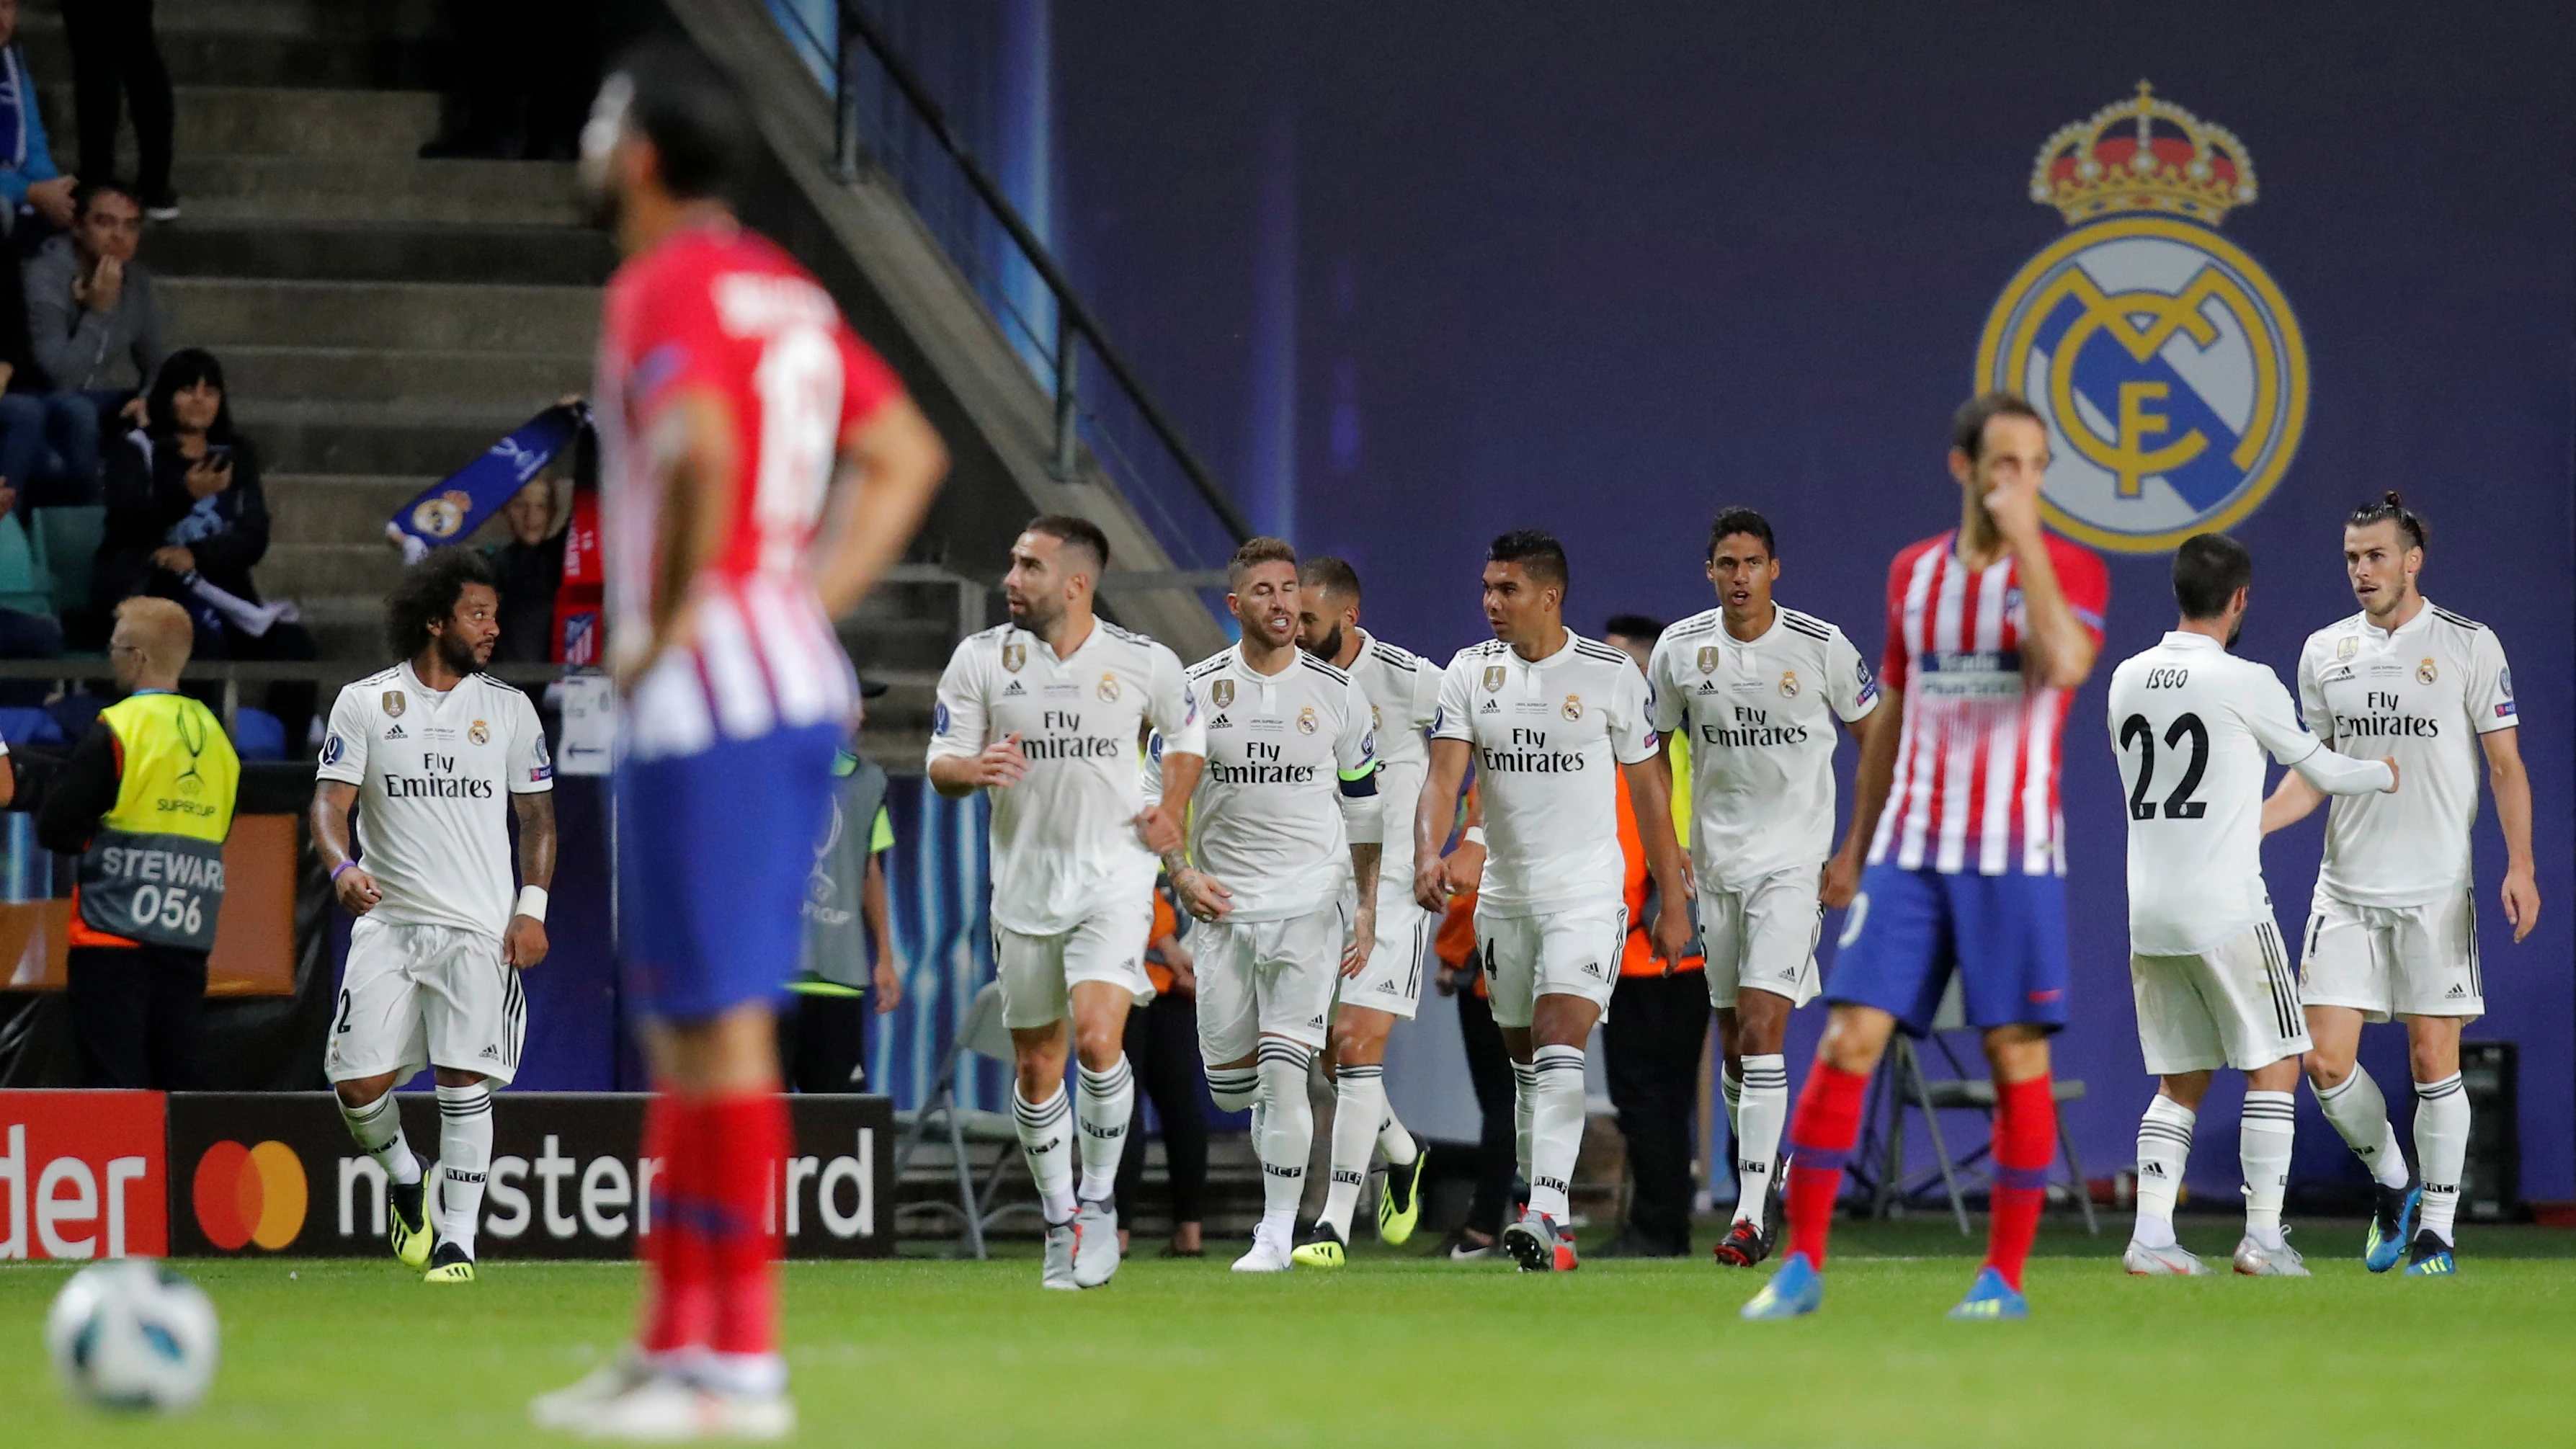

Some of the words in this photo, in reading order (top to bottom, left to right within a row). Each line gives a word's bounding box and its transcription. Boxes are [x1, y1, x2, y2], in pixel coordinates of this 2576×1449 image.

[2146, 668, 2188, 689] ISCO
[2368, 692, 2399, 710] Fly
[1044, 710, 1080, 731] Fly
[1735, 706, 1766, 725] Fly
[2335, 711, 2438, 738] Emirates
[1005, 732, 1118, 759] mirates
[1512, 728, 1546, 749] Fly
[1701, 724, 1807, 747] Emirates
[1247, 741, 1280, 762] Fly
[1483, 747, 1585, 772] Emirates
[424, 754, 455, 773] Fly
[1211, 762, 1315, 783] Emirates
[2120, 713, 2209, 821] 22
[385, 772, 492, 798] Emirates
[102, 847, 225, 892] STEWAR
[131, 885, 202, 935] 056
[339, 1128, 874, 1238] msterrd
